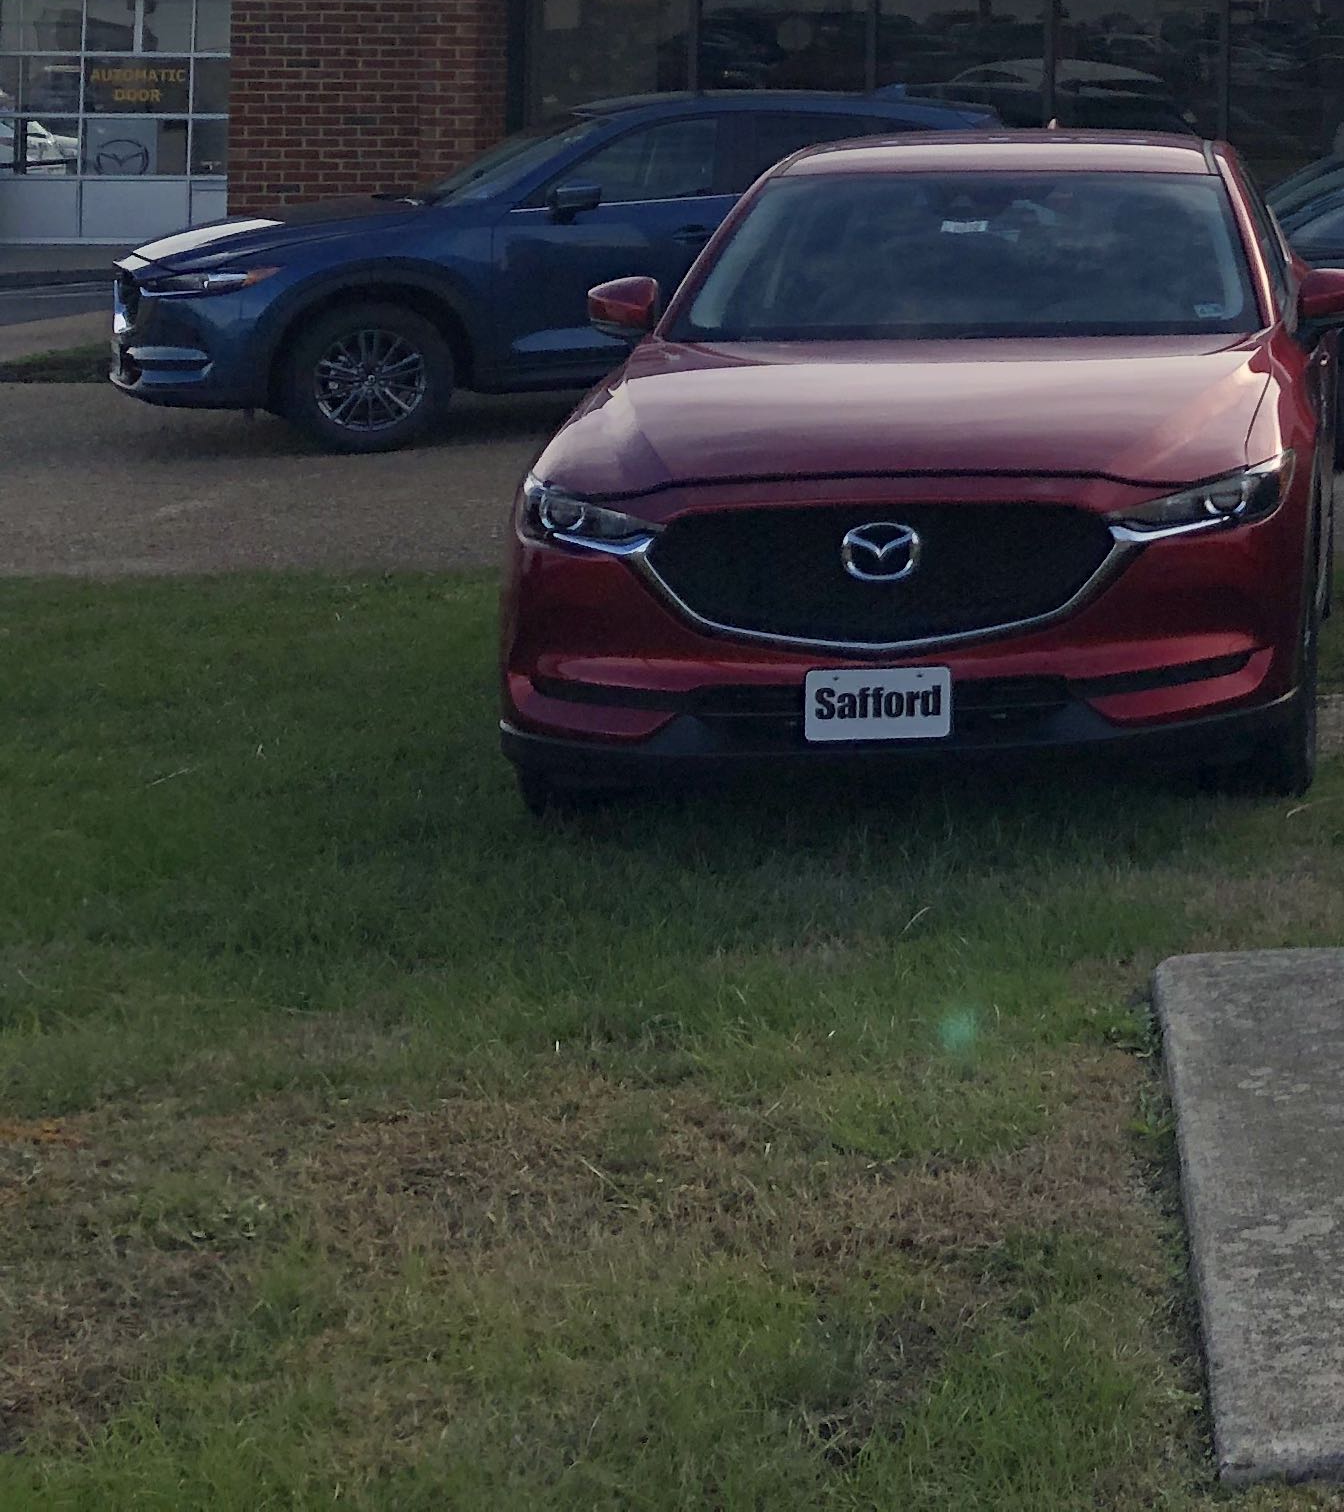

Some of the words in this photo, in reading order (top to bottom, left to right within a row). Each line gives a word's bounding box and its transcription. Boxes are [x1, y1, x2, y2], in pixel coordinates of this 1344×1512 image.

[90, 69, 186, 82] AUTOMATIC
[113, 89, 161, 101] DOOR
[815, 684, 942, 719] Safford
